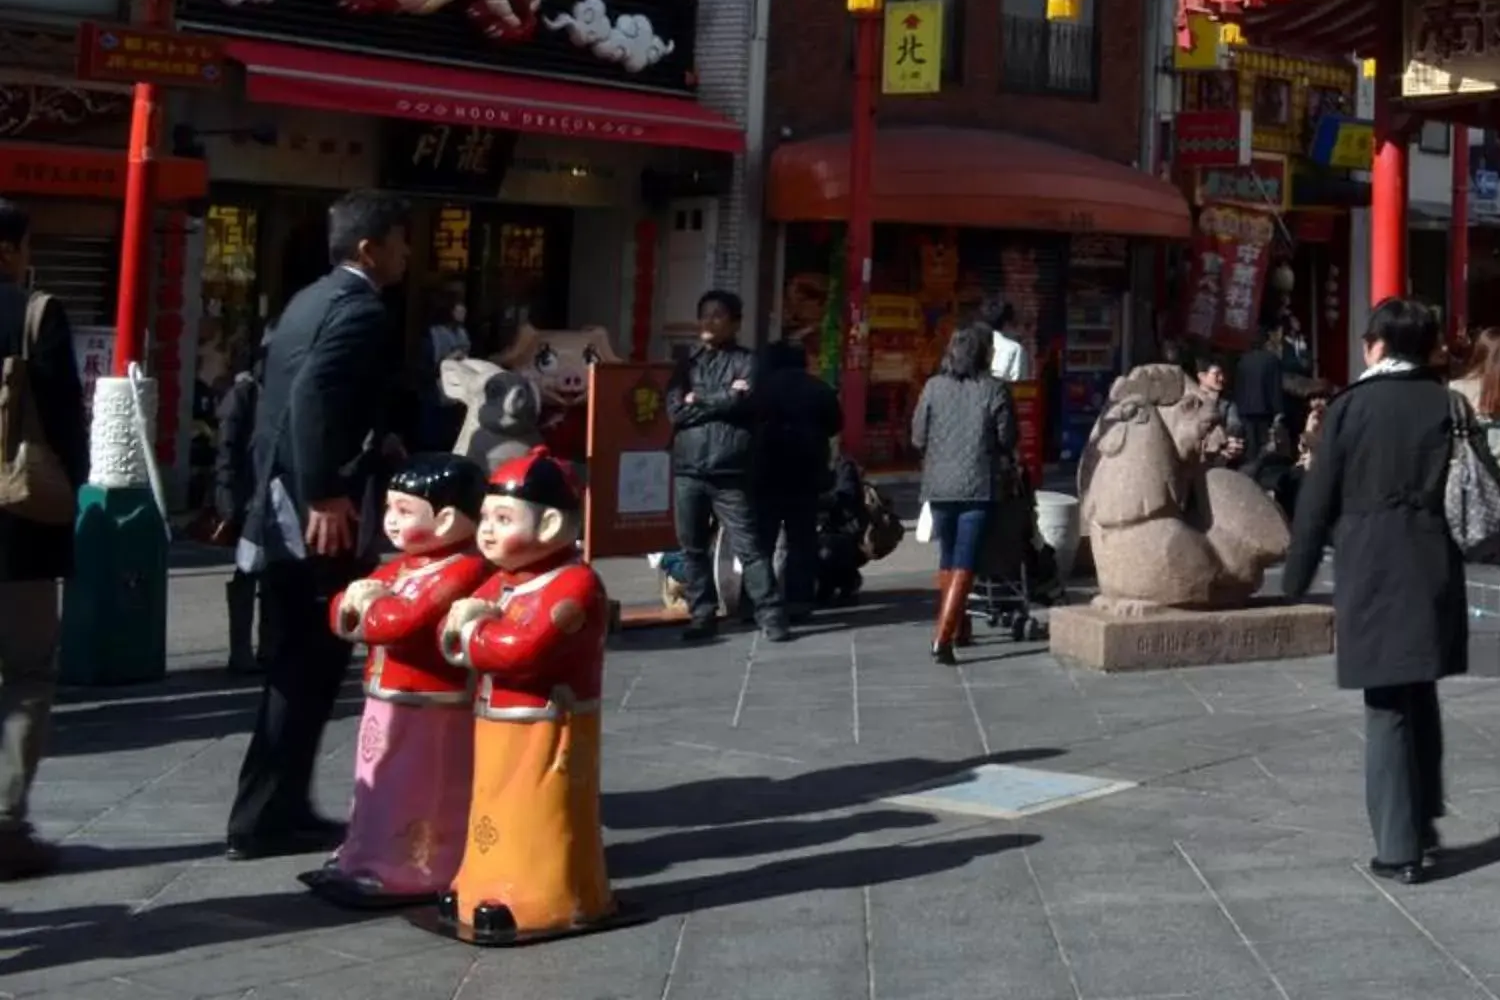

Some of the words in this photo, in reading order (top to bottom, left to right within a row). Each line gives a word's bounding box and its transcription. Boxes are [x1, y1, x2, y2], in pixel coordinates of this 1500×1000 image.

[895, 33, 928, 66] 北
[454, 106, 511, 124] MOON
[523, 112, 597, 131] DRAGON
